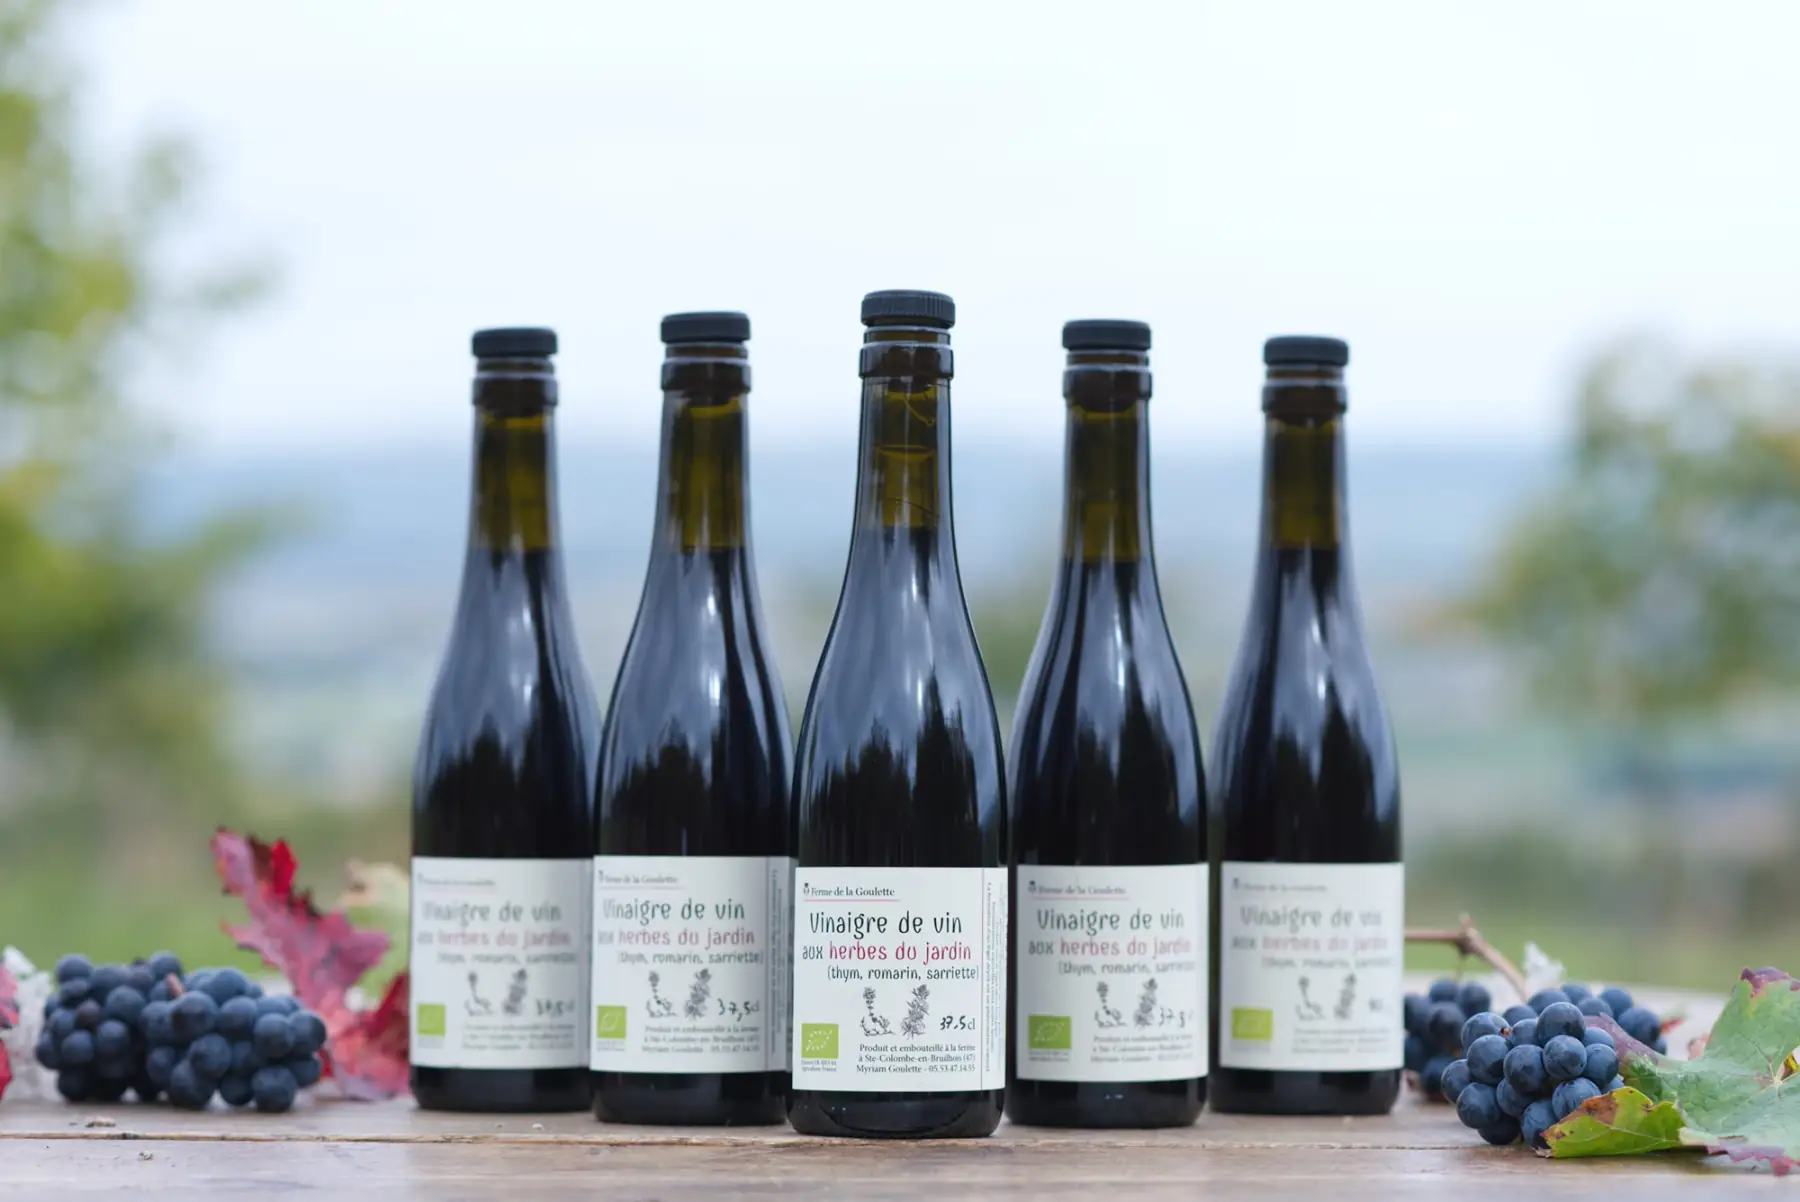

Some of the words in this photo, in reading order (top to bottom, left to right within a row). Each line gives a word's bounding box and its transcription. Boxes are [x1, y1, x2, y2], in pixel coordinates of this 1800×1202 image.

[811, 887, 832, 896] Ferme
[834, 886, 844, 896] de
[846, 886, 853, 896] la
[855, 886, 895, 896] Goulette
[603, 898, 672, 926] Vinaigre
[681, 897, 706, 920] de
[715, 898, 745, 920] vin
[1037, 909, 1120, 936] Vinaigre
[1130, 908, 1153, 930] de
[1160, 908, 1185, 929] vin
[810, 911, 888, 940] Vinaigre
[898, 910, 923, 933] de
[933, 912, 962, 933] vin
[618, 928, 671, 945] herbes
[678, 927, 699, 945] du
[704, 927, 755, 950] jardin
[1028, 940, 1054, 955] aux
[1060, 937, 1120, 956] herbes
[1127, 937, 1147, 956] du
[802, 945, 823, 960] aux
[829, 940, 887, 960] herbes
[895, 941, 917, 960] du
[923, 941, 971, 965] jardin
[827, 965, 863, 983] (thym,
[868, 966, 922, 982] romarin,
[926, 965, 980, 981] sarriette)
[859, 1044, 889, 1052] Produit
[890, 1044, 898, 1052] et
[856, 1064, 887, 1075] Myriam
[888, 1063, 922, 1073] Goulette
